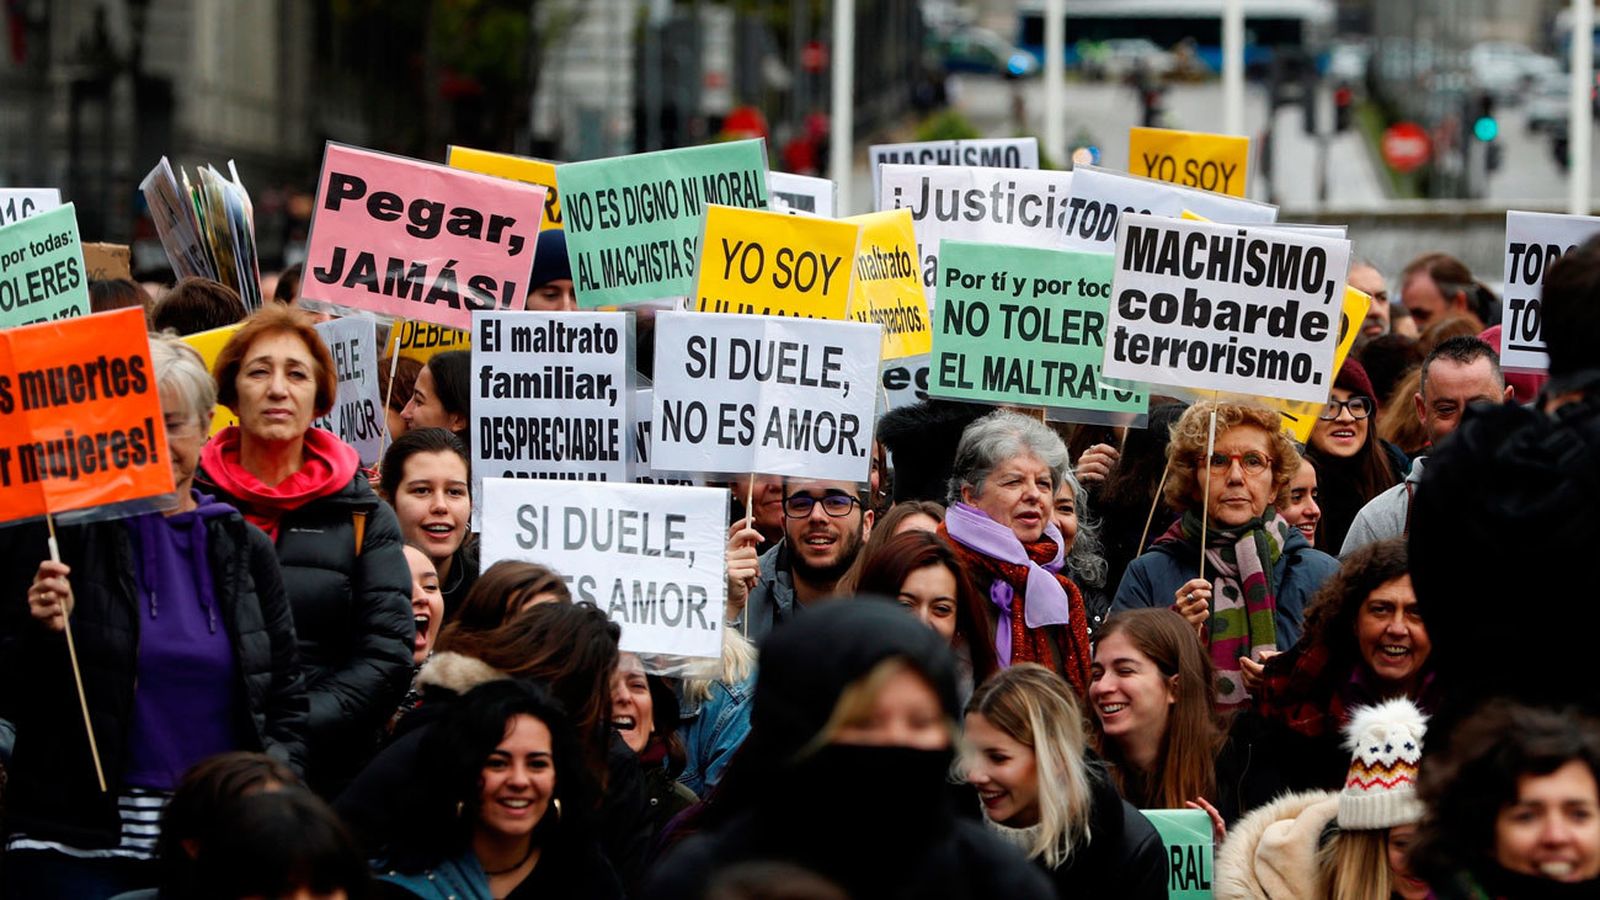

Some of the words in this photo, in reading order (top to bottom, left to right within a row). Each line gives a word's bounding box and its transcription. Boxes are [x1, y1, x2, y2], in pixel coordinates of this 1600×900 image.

[1143, 153, 1177, 182] YO
[1182, 158, 1237, 194] SOY
[324, 171, 525, 257] Pegar,
[566, 192, 594, 234] NO
[595, 189, 621, 229] ES
[623, 180, 679, 226] DIGNO
[681, 177, 701, 217] NI
[702, 170, 767, 208] MORAL
[1066, 197, 1151, 243] TOD
[1, 247, 26, 273] por
[30, 230, 73, 257] todas:
[313, 246, 516, 310] JAMÁS!
[578, 251, 600, 292] AL
[600, 239, 682, 288] MACHISTA
[721, 237, 764, 285] YO
[772, 247, 842, 296] SOY
[945, 268, 985, 289] Por
[992, 271, 1009, 291] tí
[1012, 277, 1026, 297] y
[1033, 278, 1072, 298] por
[480, 319, 501, 352] El
[511, 320, 618, 354] maltrato
[943, 299, 990, 337] NO
[1118, 288, 1329, 342] cobarde
[1509, 299, 1546, 342] TO
[685, 335, 717, 379] SI
[729, 338, 850, 398] DUELE,
[939, 352, 974, 390] EL
[1113, 326, 1323, 385] terrorismo.
[18, 355, 148, 411] muertes
[479, 365, 618, 406] familiar,
[17, 417, 158, 481] mujeres!
[480, 416, 619, 461] DESPRECIABLE
[661, 400, 708, 444] NO
[717, 402, 755, 446] ES
[762, 406, 866, 457] AMOR.
[515, 503, 549, 550] SI
[563, 506, 695, 568] DUELE,
[608, 578, 716, 631] AMOR.
